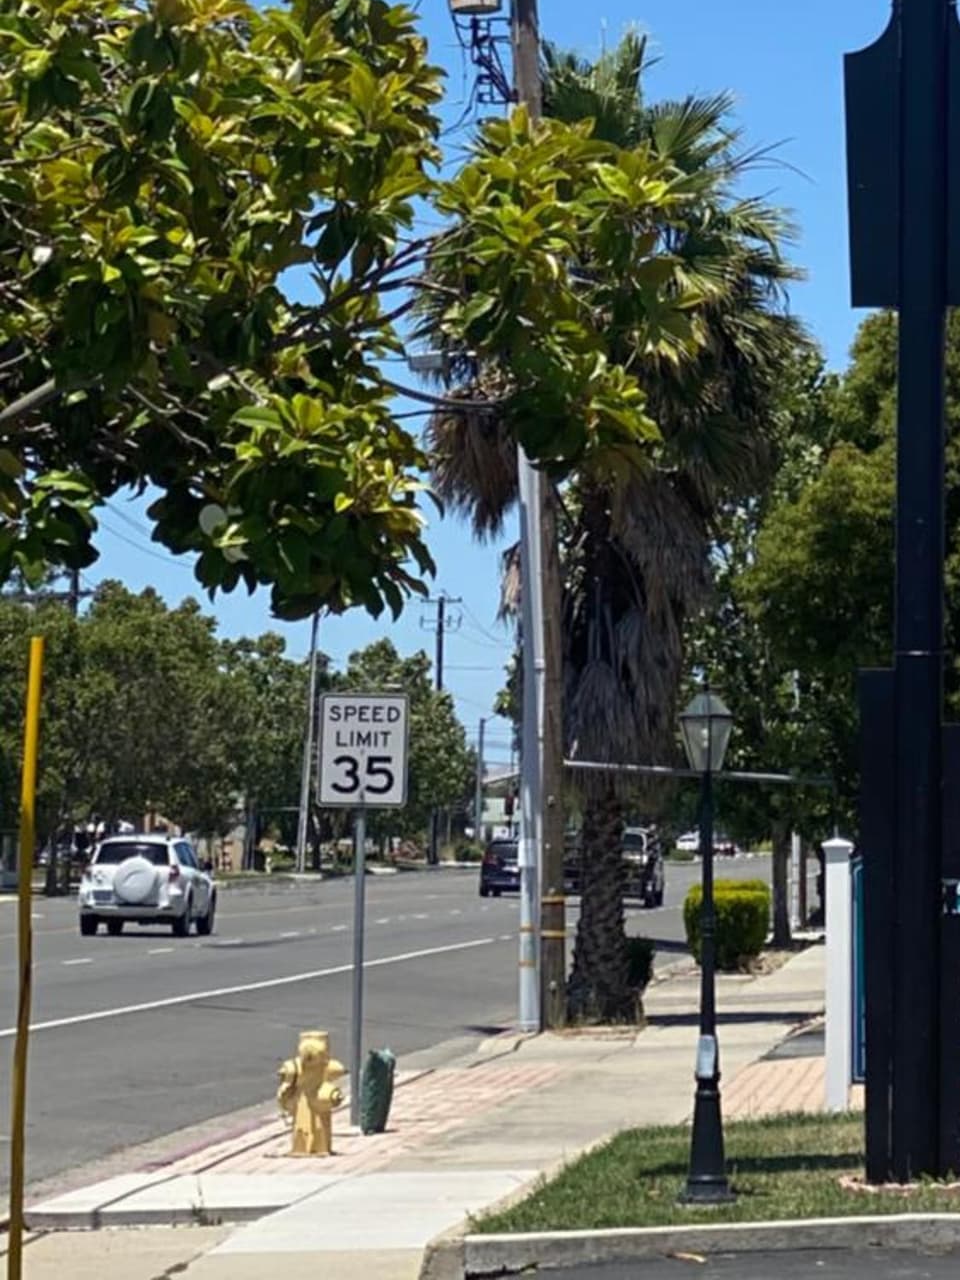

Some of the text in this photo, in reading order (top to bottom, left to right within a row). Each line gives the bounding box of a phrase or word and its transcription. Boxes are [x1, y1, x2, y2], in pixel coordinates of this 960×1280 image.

[329, 705, 401, 723] SPEED
[335, 730, 391, 747] LIMIT
[330, 755, 394, 795] 35
